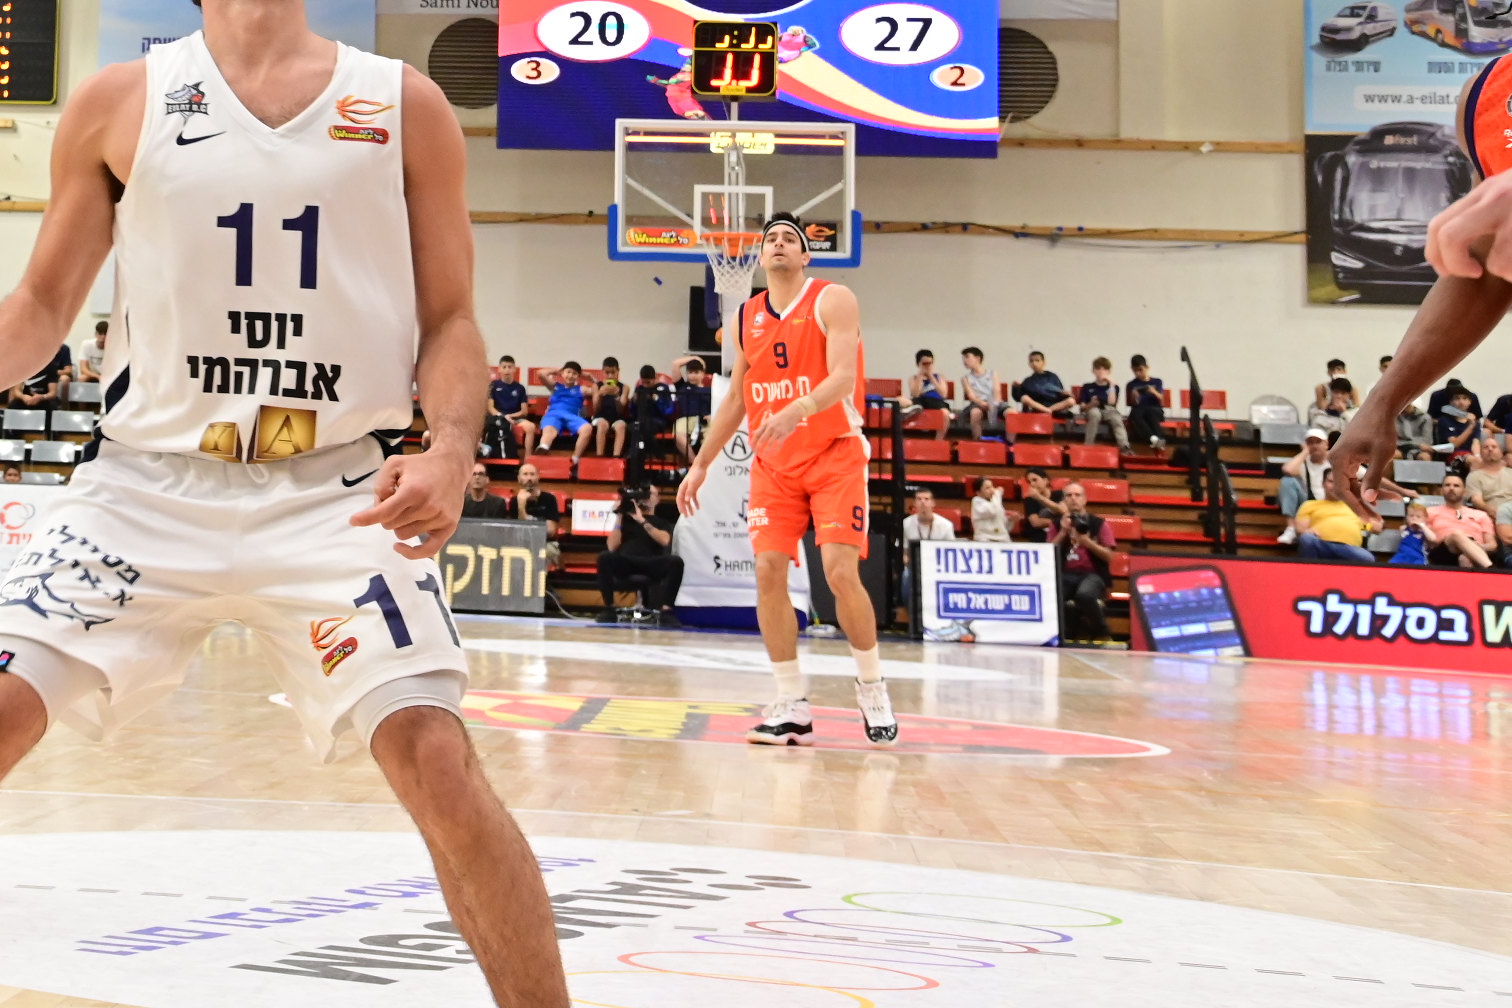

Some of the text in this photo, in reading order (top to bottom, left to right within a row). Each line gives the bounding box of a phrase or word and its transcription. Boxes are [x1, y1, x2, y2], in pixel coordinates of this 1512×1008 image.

[568, 10, 626, 47] 20
[873, 16, 934, 52] 27
[525, 59, 543, 81] 3
[950, 65, 966, 87] 2
[335, 127, 374, 141] Winner
[217, 202, 320, 289] 11
[634, 232, 677, 244] Winner
[228, 310, 303, 350] יוסי
[773, 342, 789, 369] 9
[186, 354, 342, 402] אברהמי
[261, 413, 304, 455] A
[731, 435, 747, 455] A
[851, 505, 864, 532] 9
[936, 547, 1040, 576] יחד ננצח!
[354, 572, 461, 649] 11
[968, 591, 1009, 610] ישראל
[1010, 594, 1030, 611] עם
[1297, 593, 1470, 643] בסלולר
